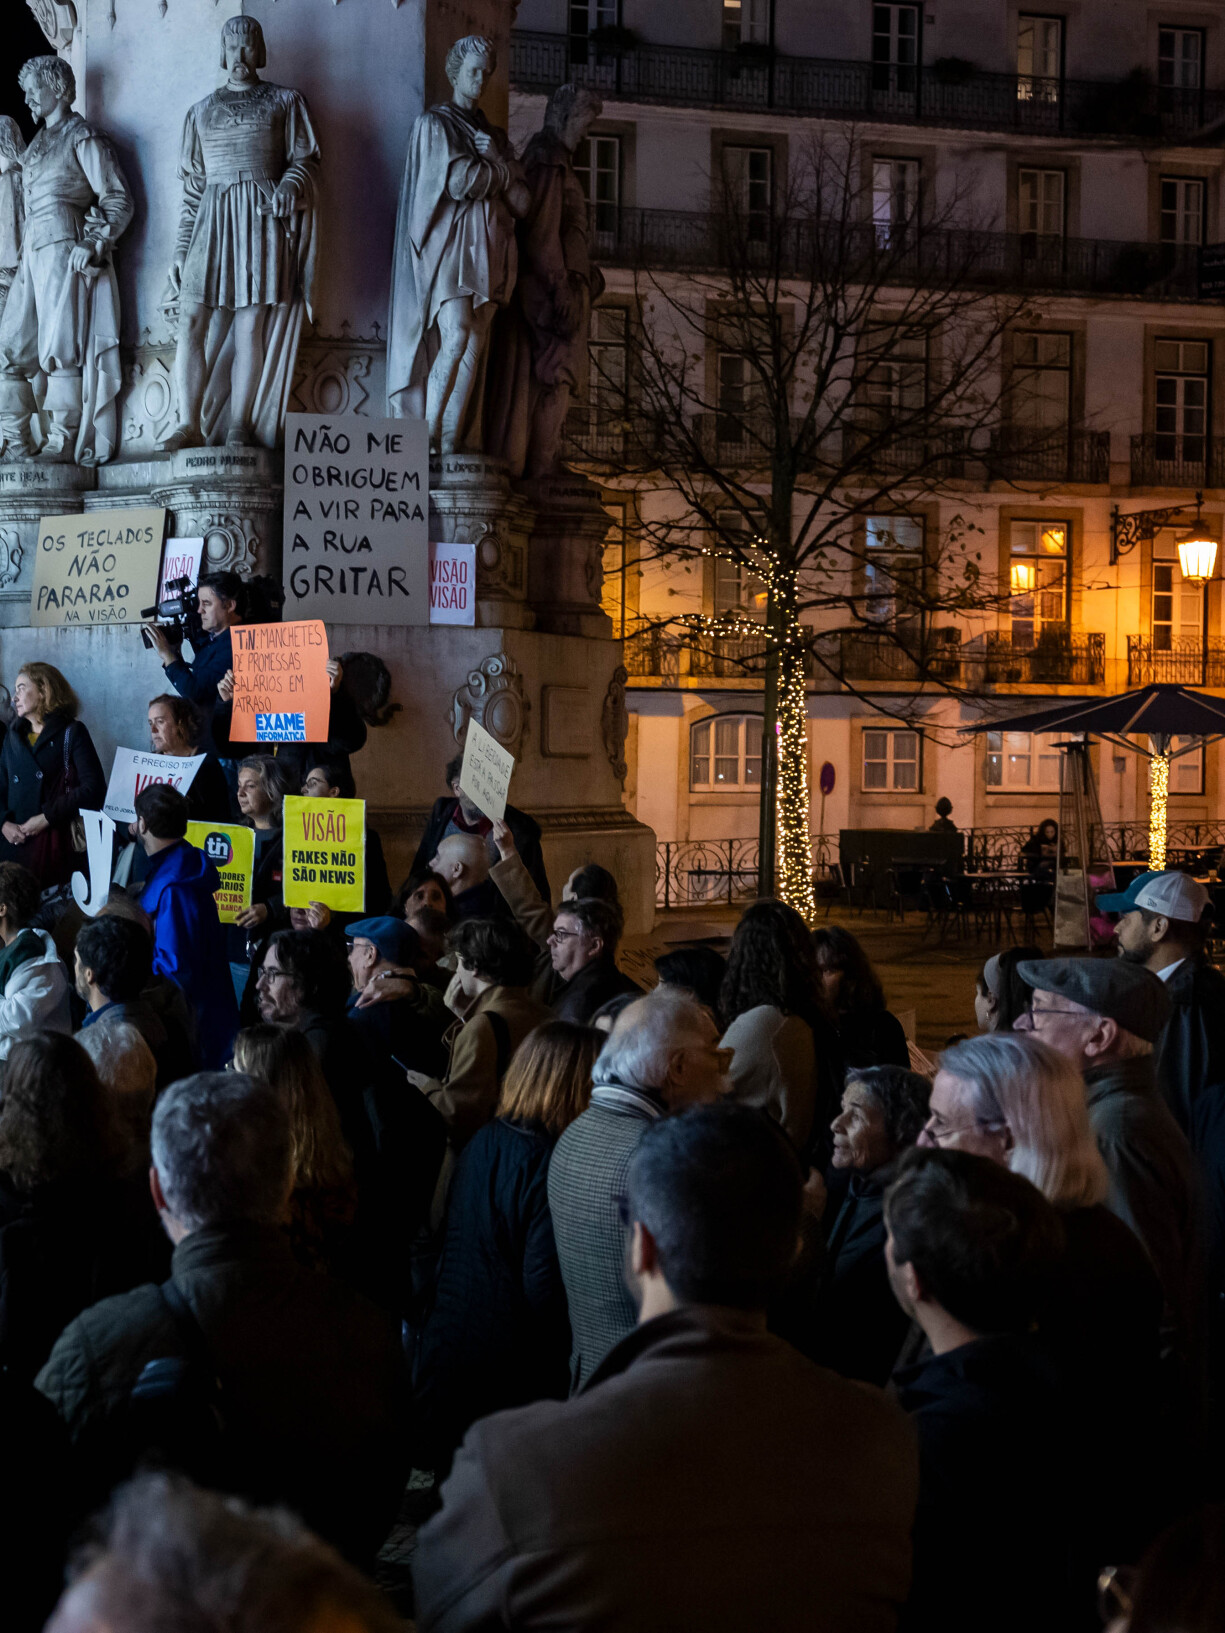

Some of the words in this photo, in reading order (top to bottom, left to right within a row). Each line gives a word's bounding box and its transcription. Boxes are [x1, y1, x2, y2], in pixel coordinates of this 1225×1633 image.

[294, 424, 350, 454] NÃO
[367, 433, 404, 454] ME
[186, 456, 216, 467] PEDRO
[292, 464, 420, 492] OBRIGUEM
[293, 500, 312, 521] A
[320, 500, 360, 521] VIR
[370, 499, 424, 522] PARA
[42, 535, 66, 552] OS
[77, 527, 154, 549] TECLADOS
[292, 532, 310, 552] A
[323, 530, 373, 554] RUA
[68, 549, 116, 578] NÃO
[165, 554, 194, 580] VISÃO
[431, 558, 468, 584] VISÃO
[290, 565, 410, 599] GRITAR
[37, 577, 129, 611] PARARÃO
[429, 584, 467, 610] VISÃO
[64, 610, 80, 622] NA
[89, 604, 127, 622] VISÃO
[260, 624, 323, 649] MANCHETES
[234, 653, 243, 672] DE
[248, 652, 302, 673] PROMESSAS
[234, 674, 283, 693] SALÁRIOS
[289, 674, 304, 693] EM
[234, 695, 272, 713] ATRASO
[256, 713, 305, 731] EXAME
[133, 755, 139, 764] É
[141, 757, 180, 769] PRECISO
[181, 761, 194, 769] TER
[302, 810, 346, 843] VISÃO
[292, 850, 328, 865] FAKES
[331, 850, 356, 867] NÃO
[292, 866, 316, 882] SÃO
[319, 871, 355, 885] NEWS
[215, 892, 243, 904] VISTAS
[221, 904, 242, 913] BANCA
